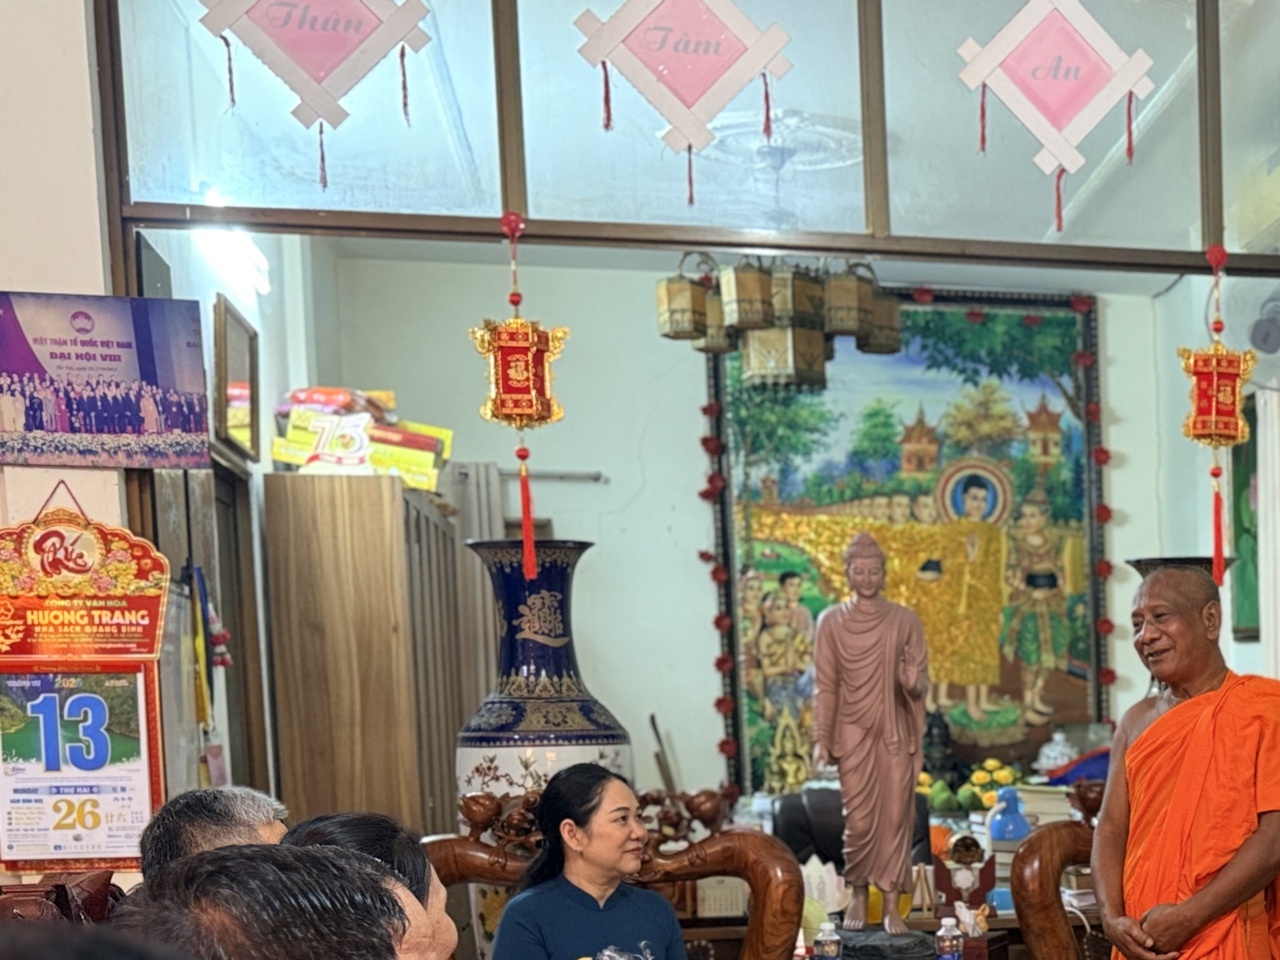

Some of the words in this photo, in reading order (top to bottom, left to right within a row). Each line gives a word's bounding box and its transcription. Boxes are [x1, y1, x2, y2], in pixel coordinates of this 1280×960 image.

[266, 2, 363, 34] Thân
[644, 25, 722, 56] Tâm
[1031, 55, 1081, 81] An
[50, 352, 72, 362] ĐẠI
[75, 352, 97, 362] HỘI
[99, 353, 122, 363] VIII
[26, 609, 89, 625] HƯƠNG
[91, 610, 150, 625] TRANG
[72, 599, 85, 607] TY
[27, 693, 111, 773] 13
[52, 798, 102, 831] 26
